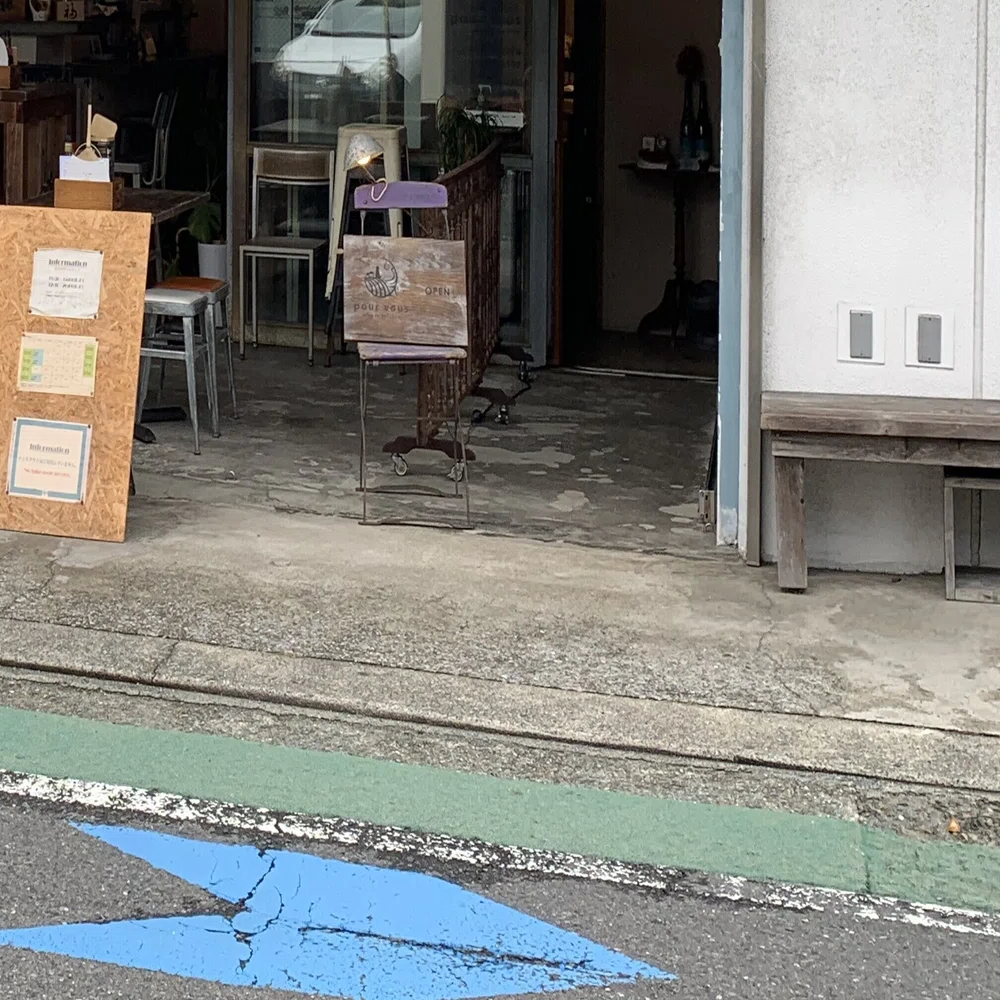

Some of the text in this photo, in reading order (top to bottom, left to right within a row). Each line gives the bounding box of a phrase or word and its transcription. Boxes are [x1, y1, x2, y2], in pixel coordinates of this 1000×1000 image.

[48, 258, 88, 268] Information
[424, 286, 450, 296] OPEN
[353, 303, 409, 313] pour vous
[29, 443, 70, 455] Information
